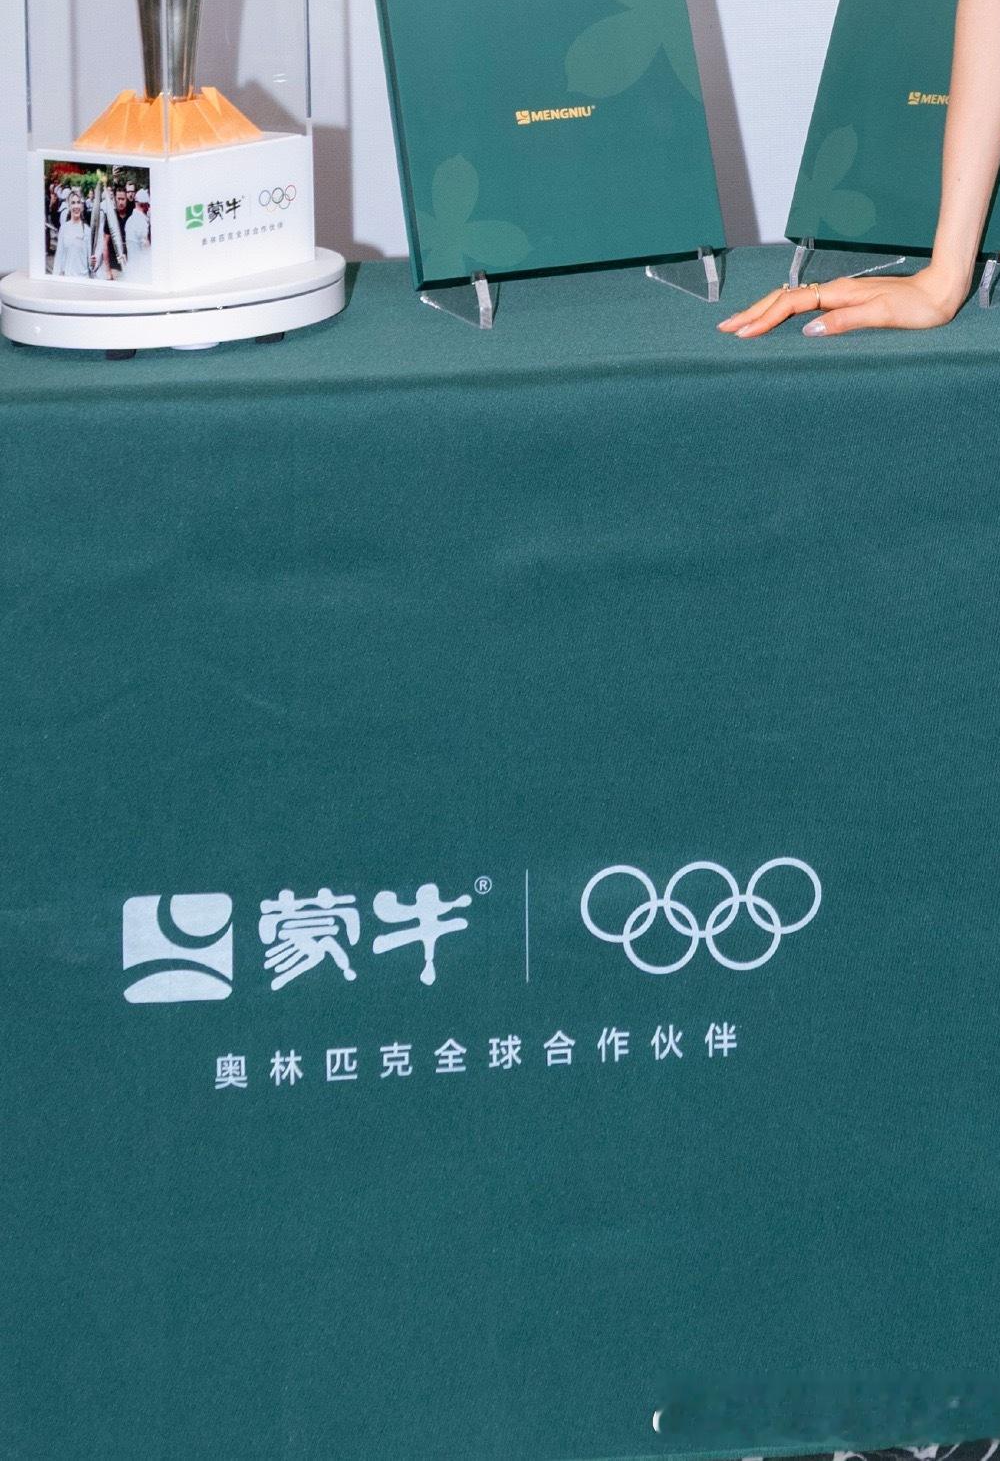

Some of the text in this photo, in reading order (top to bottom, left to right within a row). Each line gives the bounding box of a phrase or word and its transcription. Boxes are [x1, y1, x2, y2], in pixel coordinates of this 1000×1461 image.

[531, 105, 592, 122] MENGNIU
[207, 197, 242, 223] 蒙牛
[214, 1022, 738, 1090] 奥林匹克全球合作伙伴
